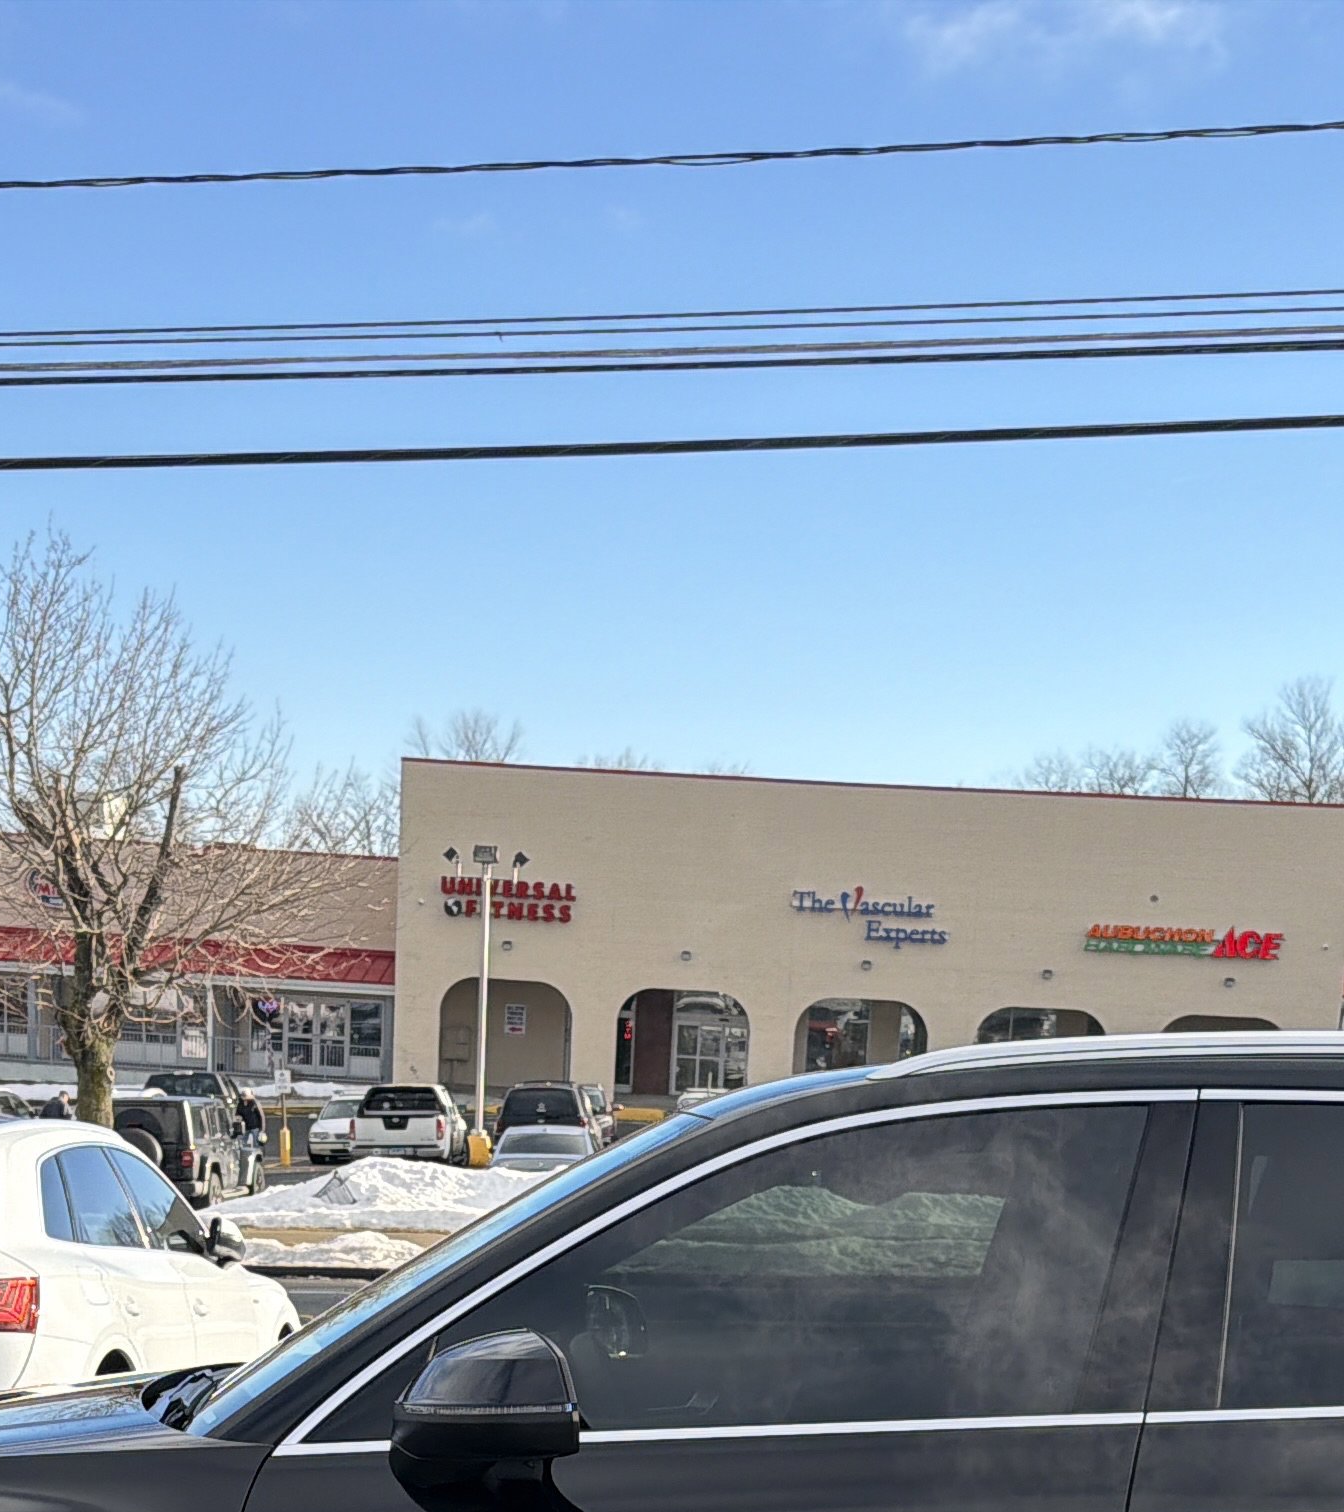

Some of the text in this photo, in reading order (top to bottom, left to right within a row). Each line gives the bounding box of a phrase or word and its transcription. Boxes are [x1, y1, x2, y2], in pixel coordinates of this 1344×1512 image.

[464, 899, 572, 923] FTNESS
[792, 885, 936, 923] The Vascular
[864, 919, 949, 950] Experts
[1085, 923, 1216, 943] AUBUCHON
[1211, 925, 1286, 960] ACE
